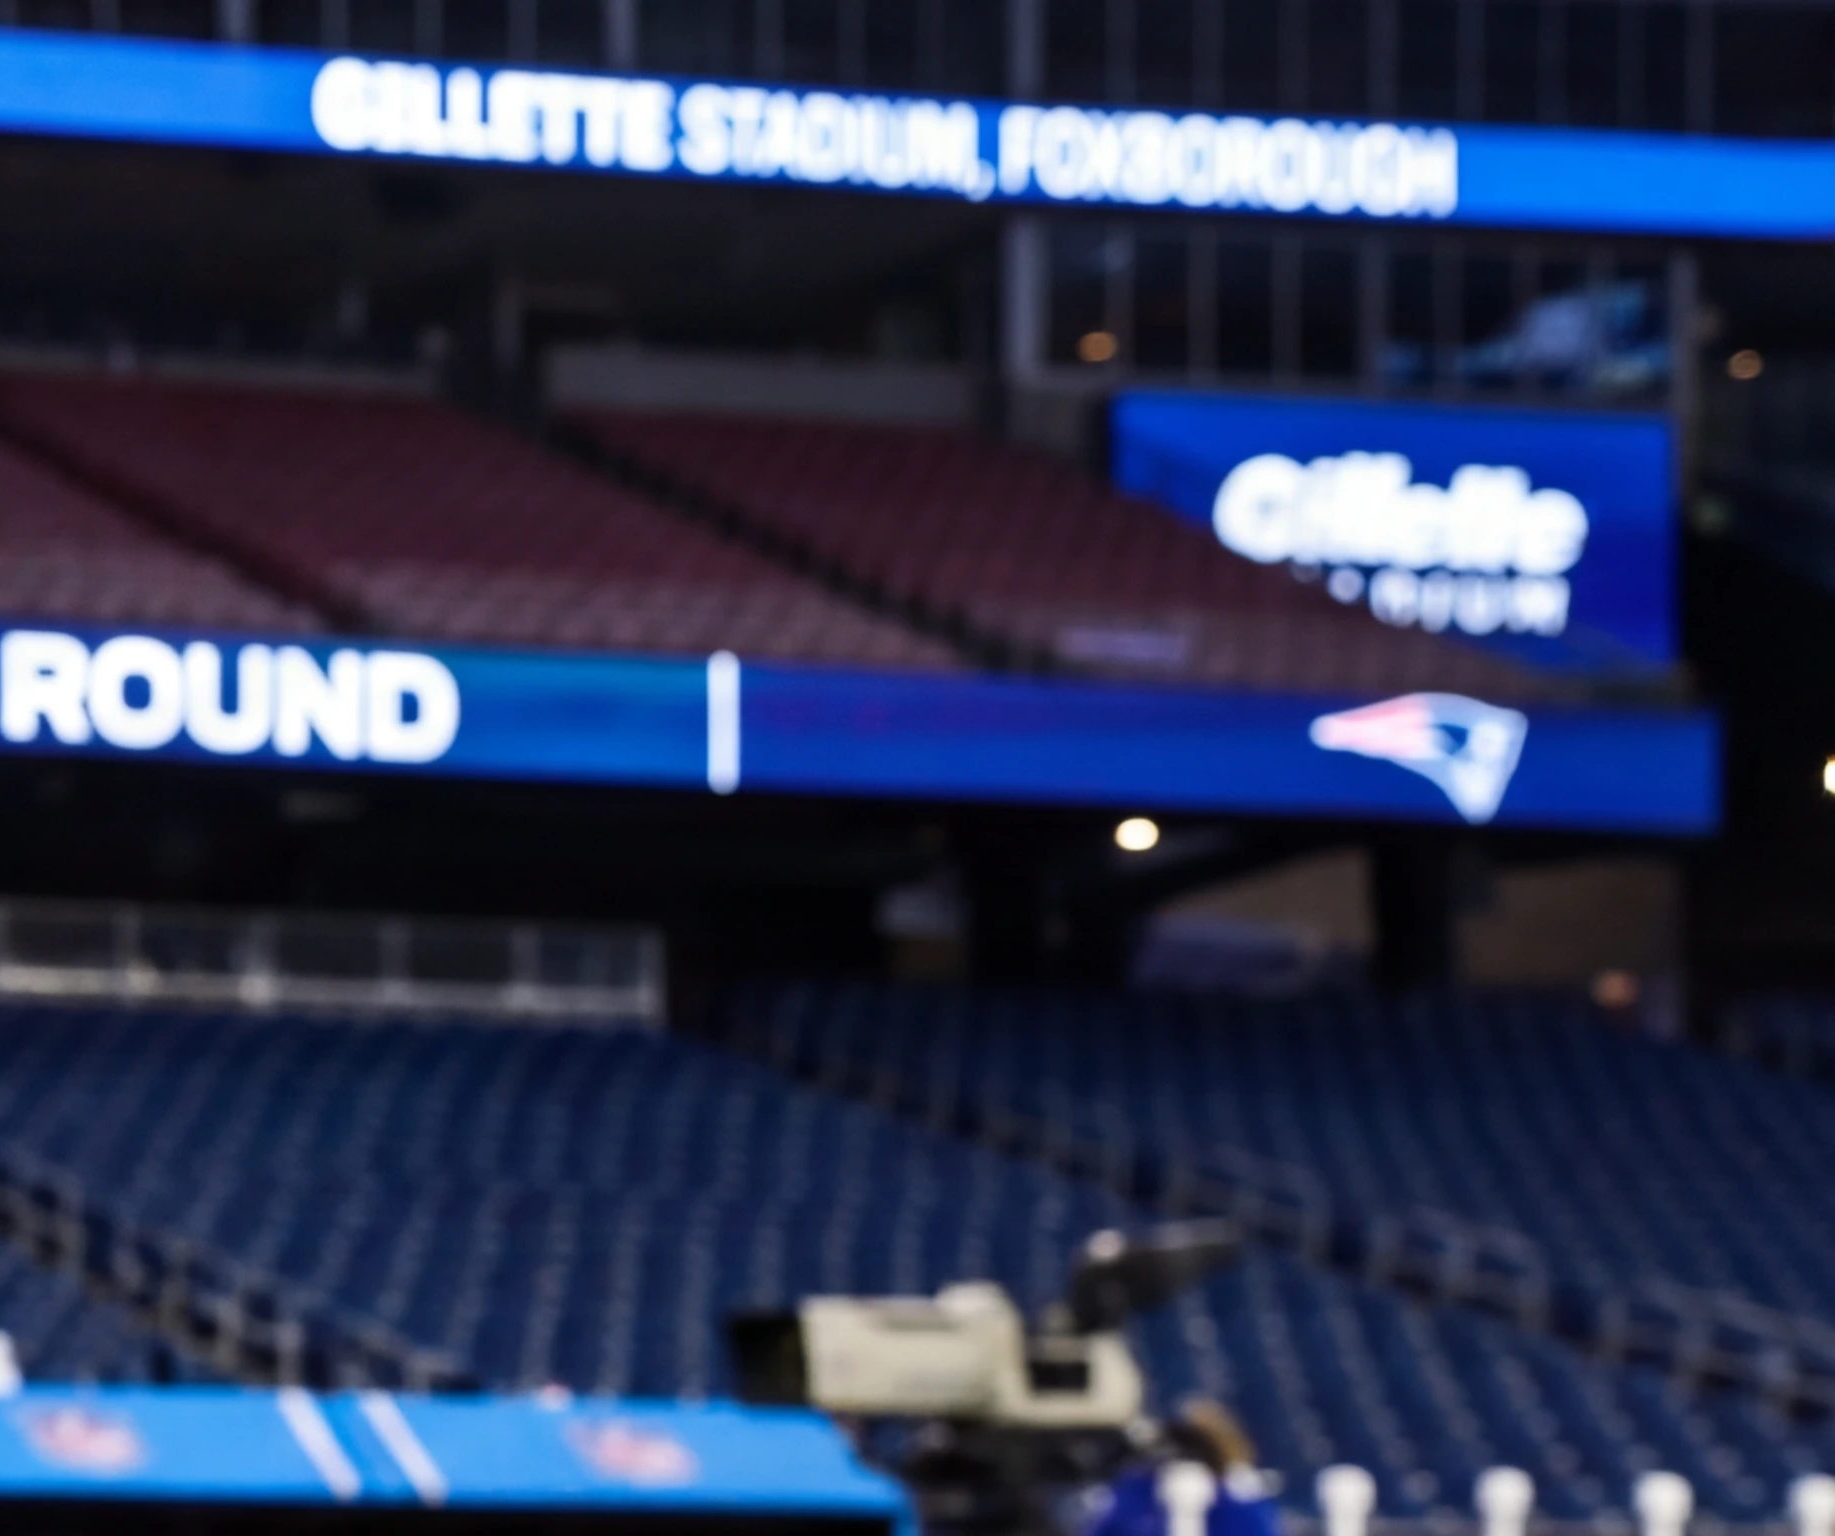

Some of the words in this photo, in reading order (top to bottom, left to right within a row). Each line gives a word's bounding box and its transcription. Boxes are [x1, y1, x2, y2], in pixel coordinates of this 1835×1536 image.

[312, 58, 673, 172] GILLETTE
[1000, 106, 1459, 217] FOXBOROUGH
[0, 630, 461, 764] ROUND
